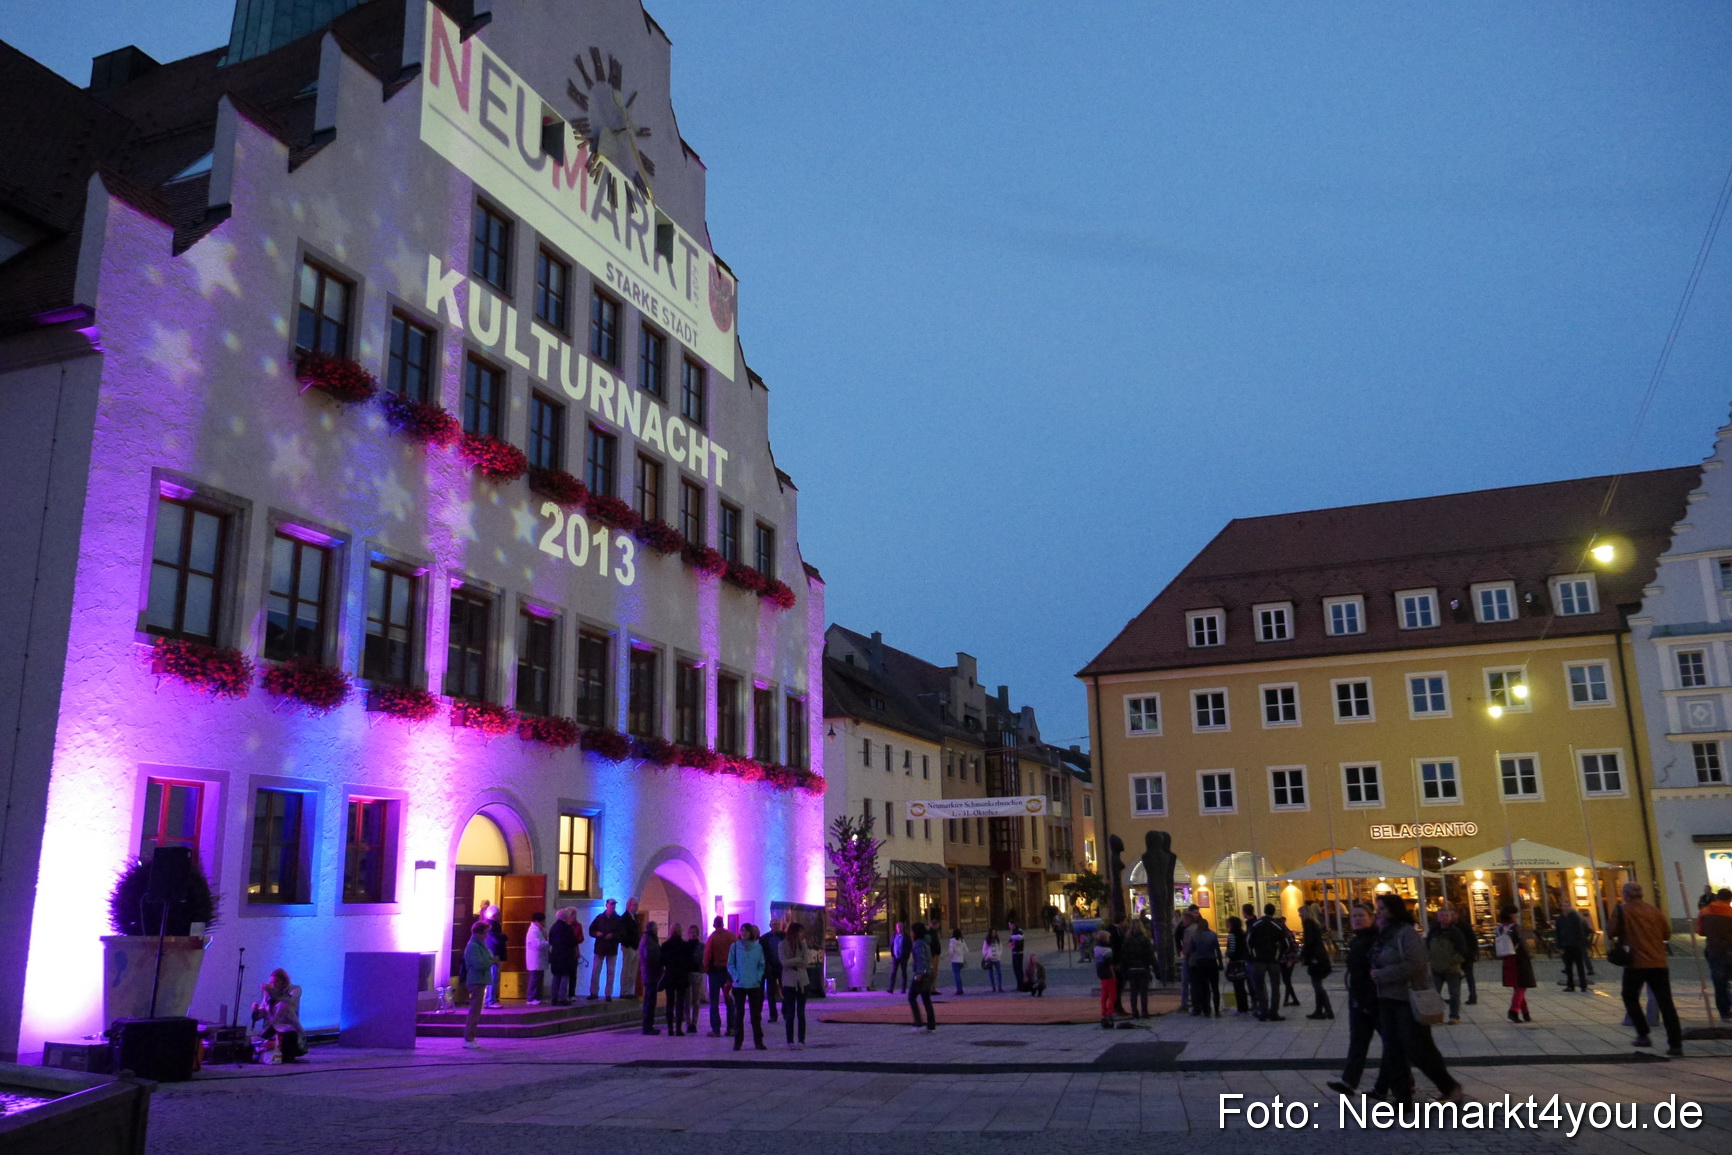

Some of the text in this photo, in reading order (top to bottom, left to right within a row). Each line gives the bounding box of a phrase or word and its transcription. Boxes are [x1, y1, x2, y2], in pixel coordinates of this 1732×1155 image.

[606, 261, 658, 318] STARKE
[662, 306, 698, 349] STADT
[426, 254, 728, 488] KULTURNACHT
[539, 502, 635, 587] 2013
[928, 799, 1022, 809] Neumarkter Schmankerlwochen
[1370, 822, 1478, 839] BELACCANTO
